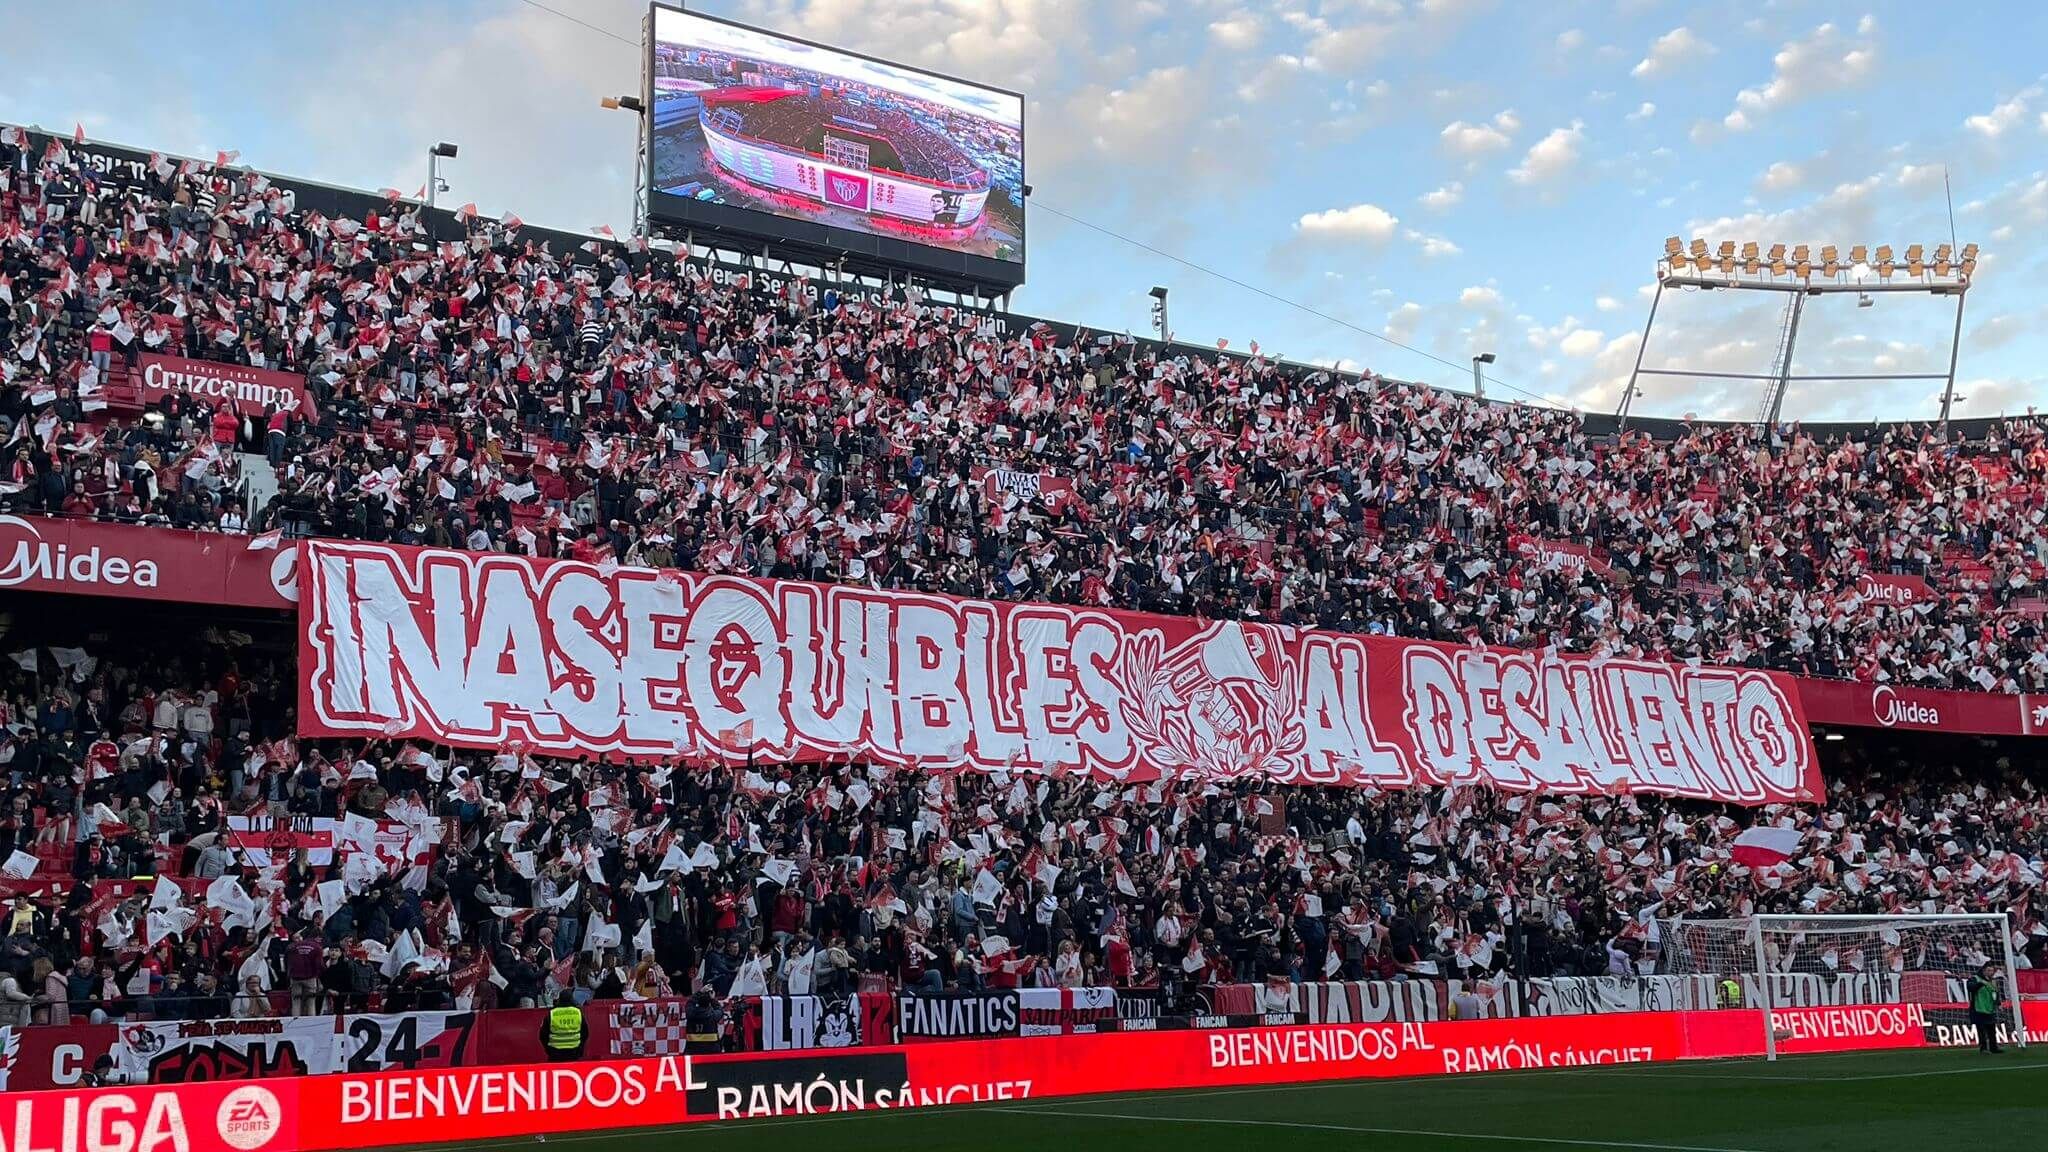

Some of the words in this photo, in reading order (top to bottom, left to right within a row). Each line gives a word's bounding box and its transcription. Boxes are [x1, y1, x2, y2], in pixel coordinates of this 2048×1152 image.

[0, 540, 158, 587] Midea
[1298, 640, 1410, 782] AL
[1405, 648, 1806, 800] DESALIENTO
[1884, 699, 1939, 724] Midea
[900, 995, 1017, 1035] FANATICS
[1123, 1018, 1157, 1031] FANCAM
[1196, 1016, 1228, 1028] FANCAM
[1264, 1013, 1296, 1026] FANCAM
[1770, 1007, 1906, 1039] BIENVENIDOS
[1906, 1003, 1933, 1027] AL
[347, 1012, 475, 1073] 24-7
[1209, 1027, 1399, 1068] BIENVENIDOS
[1401, 1022, 1436, 1050] AL
[1936, 1023, 2009, 1047] RAMN
[1443, 1037, 1544, 1074] RAMÓN
[341, 1065, 647, 1124] BIENVENIDOS
[655, 1055, 708, 1092] AL
[717, 1072, 865, 1120] RAMÓN
[0, 1091, 190, 1152] LIGA
[226, 1120, 271, 1133] SPORTS
[228, 1100, 269, 1122] EA
